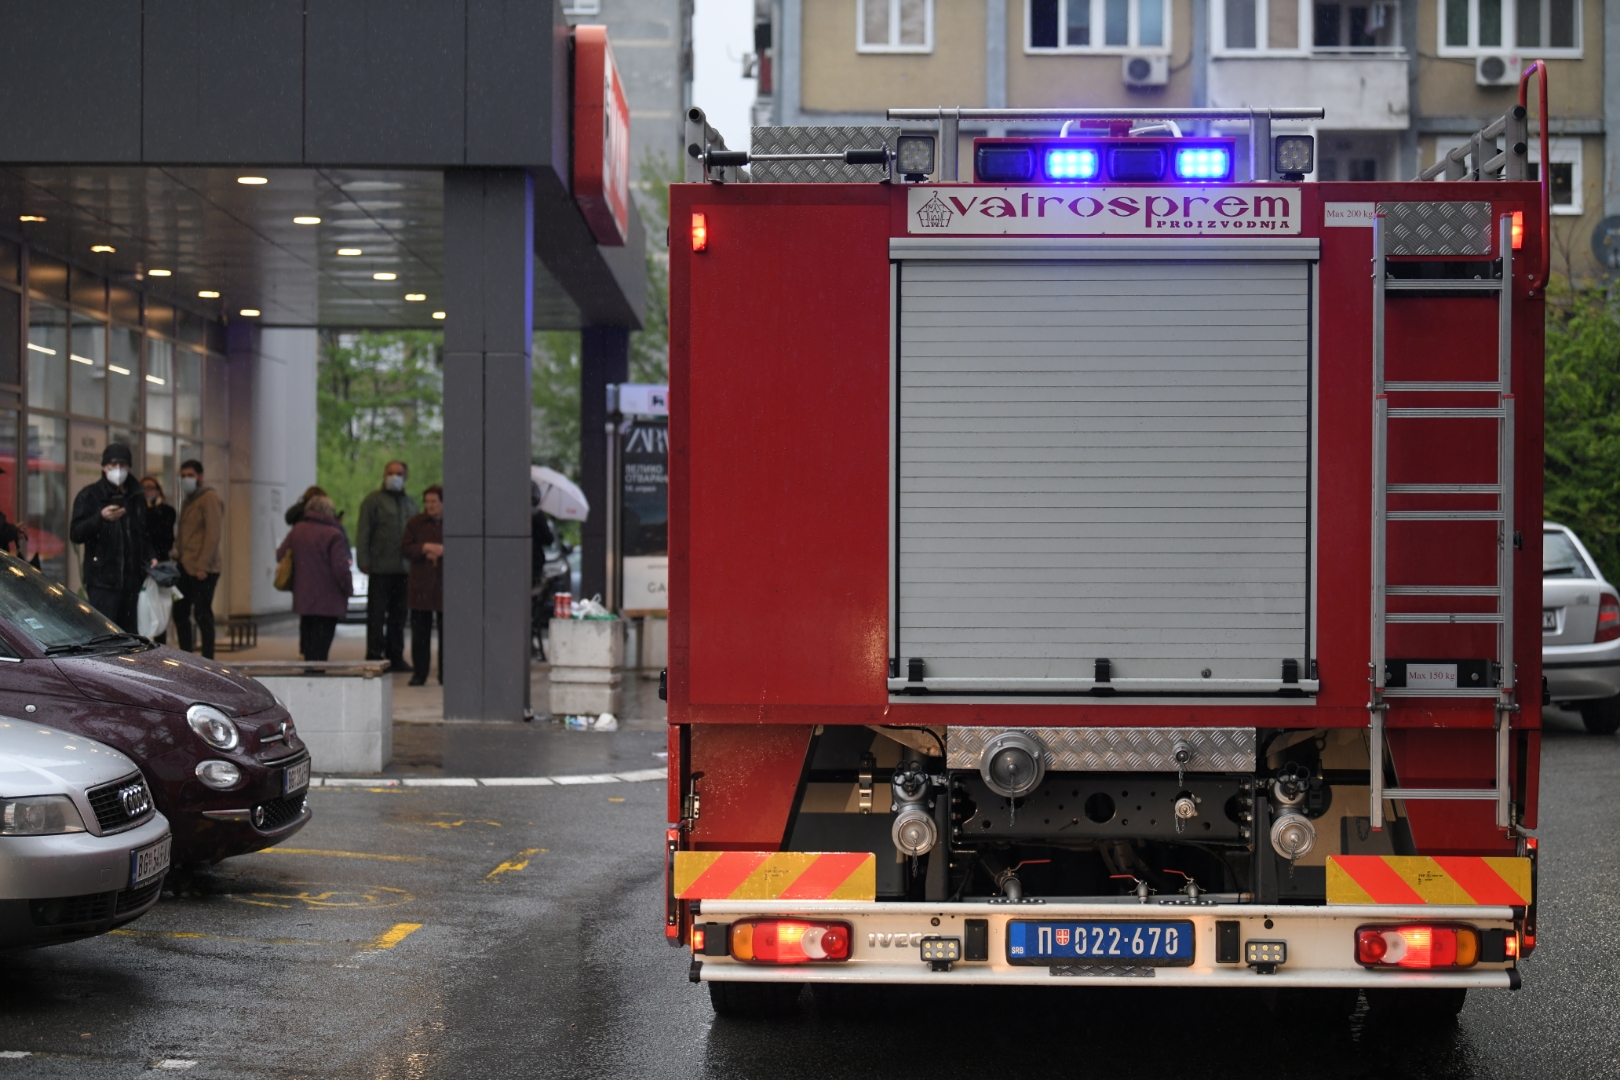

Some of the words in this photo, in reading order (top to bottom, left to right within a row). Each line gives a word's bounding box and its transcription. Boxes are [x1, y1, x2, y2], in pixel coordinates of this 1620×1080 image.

[948, 192, 1290, 229] vatrosprem
[1327, 210, 1344, 218] Max
[1347, 210, 1361, 218] 200
[1364, 210, 1373, 220] kg
[1156, 220, 1290, 229] PROIZVODNJA
[1409, 672, 1426, 680] Max
[1429, 671, 1444, 680] 150
[1445, 672, 1455, 682] kg
[138, 852, 149, 878] BG
[868, 932, 940, 949] IVEC
[1011, 946, 1024, 955] SRB
